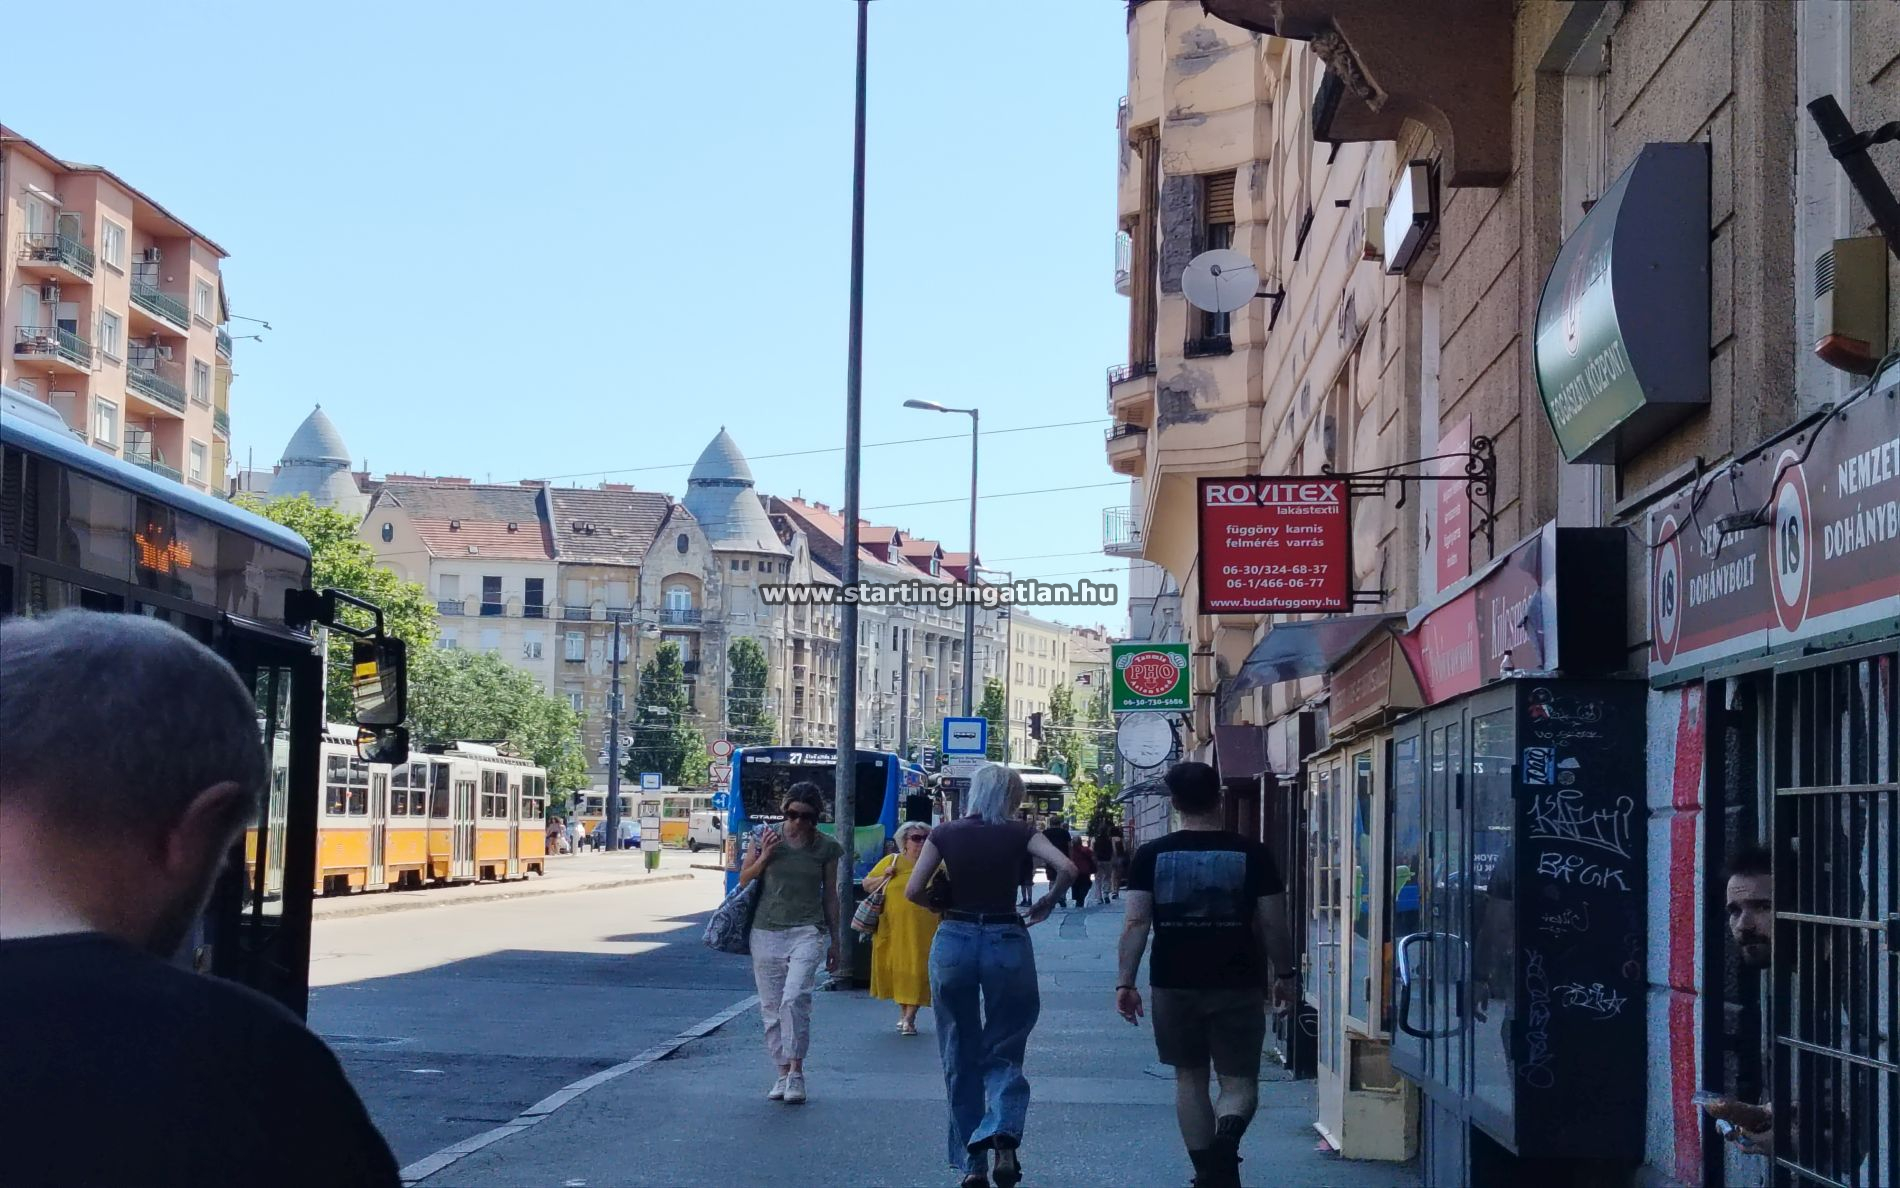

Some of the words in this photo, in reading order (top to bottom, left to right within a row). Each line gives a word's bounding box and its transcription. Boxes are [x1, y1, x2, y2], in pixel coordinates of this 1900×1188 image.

[1583, 340, 1627, 397] KÖZPONT
[1206, 484, 1339, 503] ROVITEX
[1277, 506, 1340, 515] lakástextil
[1226, 525, 1279, 536] függöny
[1286, 524, 1324, 534] karnis
[1824, 501, 1900, 560] DOHÁNYB
[1226, 537, 1280, 548] felmérés
[1286, 537, 1324, 548] varrás
[1781, 515, 1799, 576] 18
[1223, 564, 1329, 576] 06-30/324-68-37
[1226, 578, 1325, 589] 06-1/466-06-77
[1690, 553, 1756, 607] DOHÁNYBOLT
[1661, 568, 1674, 619] 18
[1210, 598, 1341, 608] www.budafuggony.hu
[1131, 663, 1175, 680] PHO
[789, 752, 802, 765] 27
